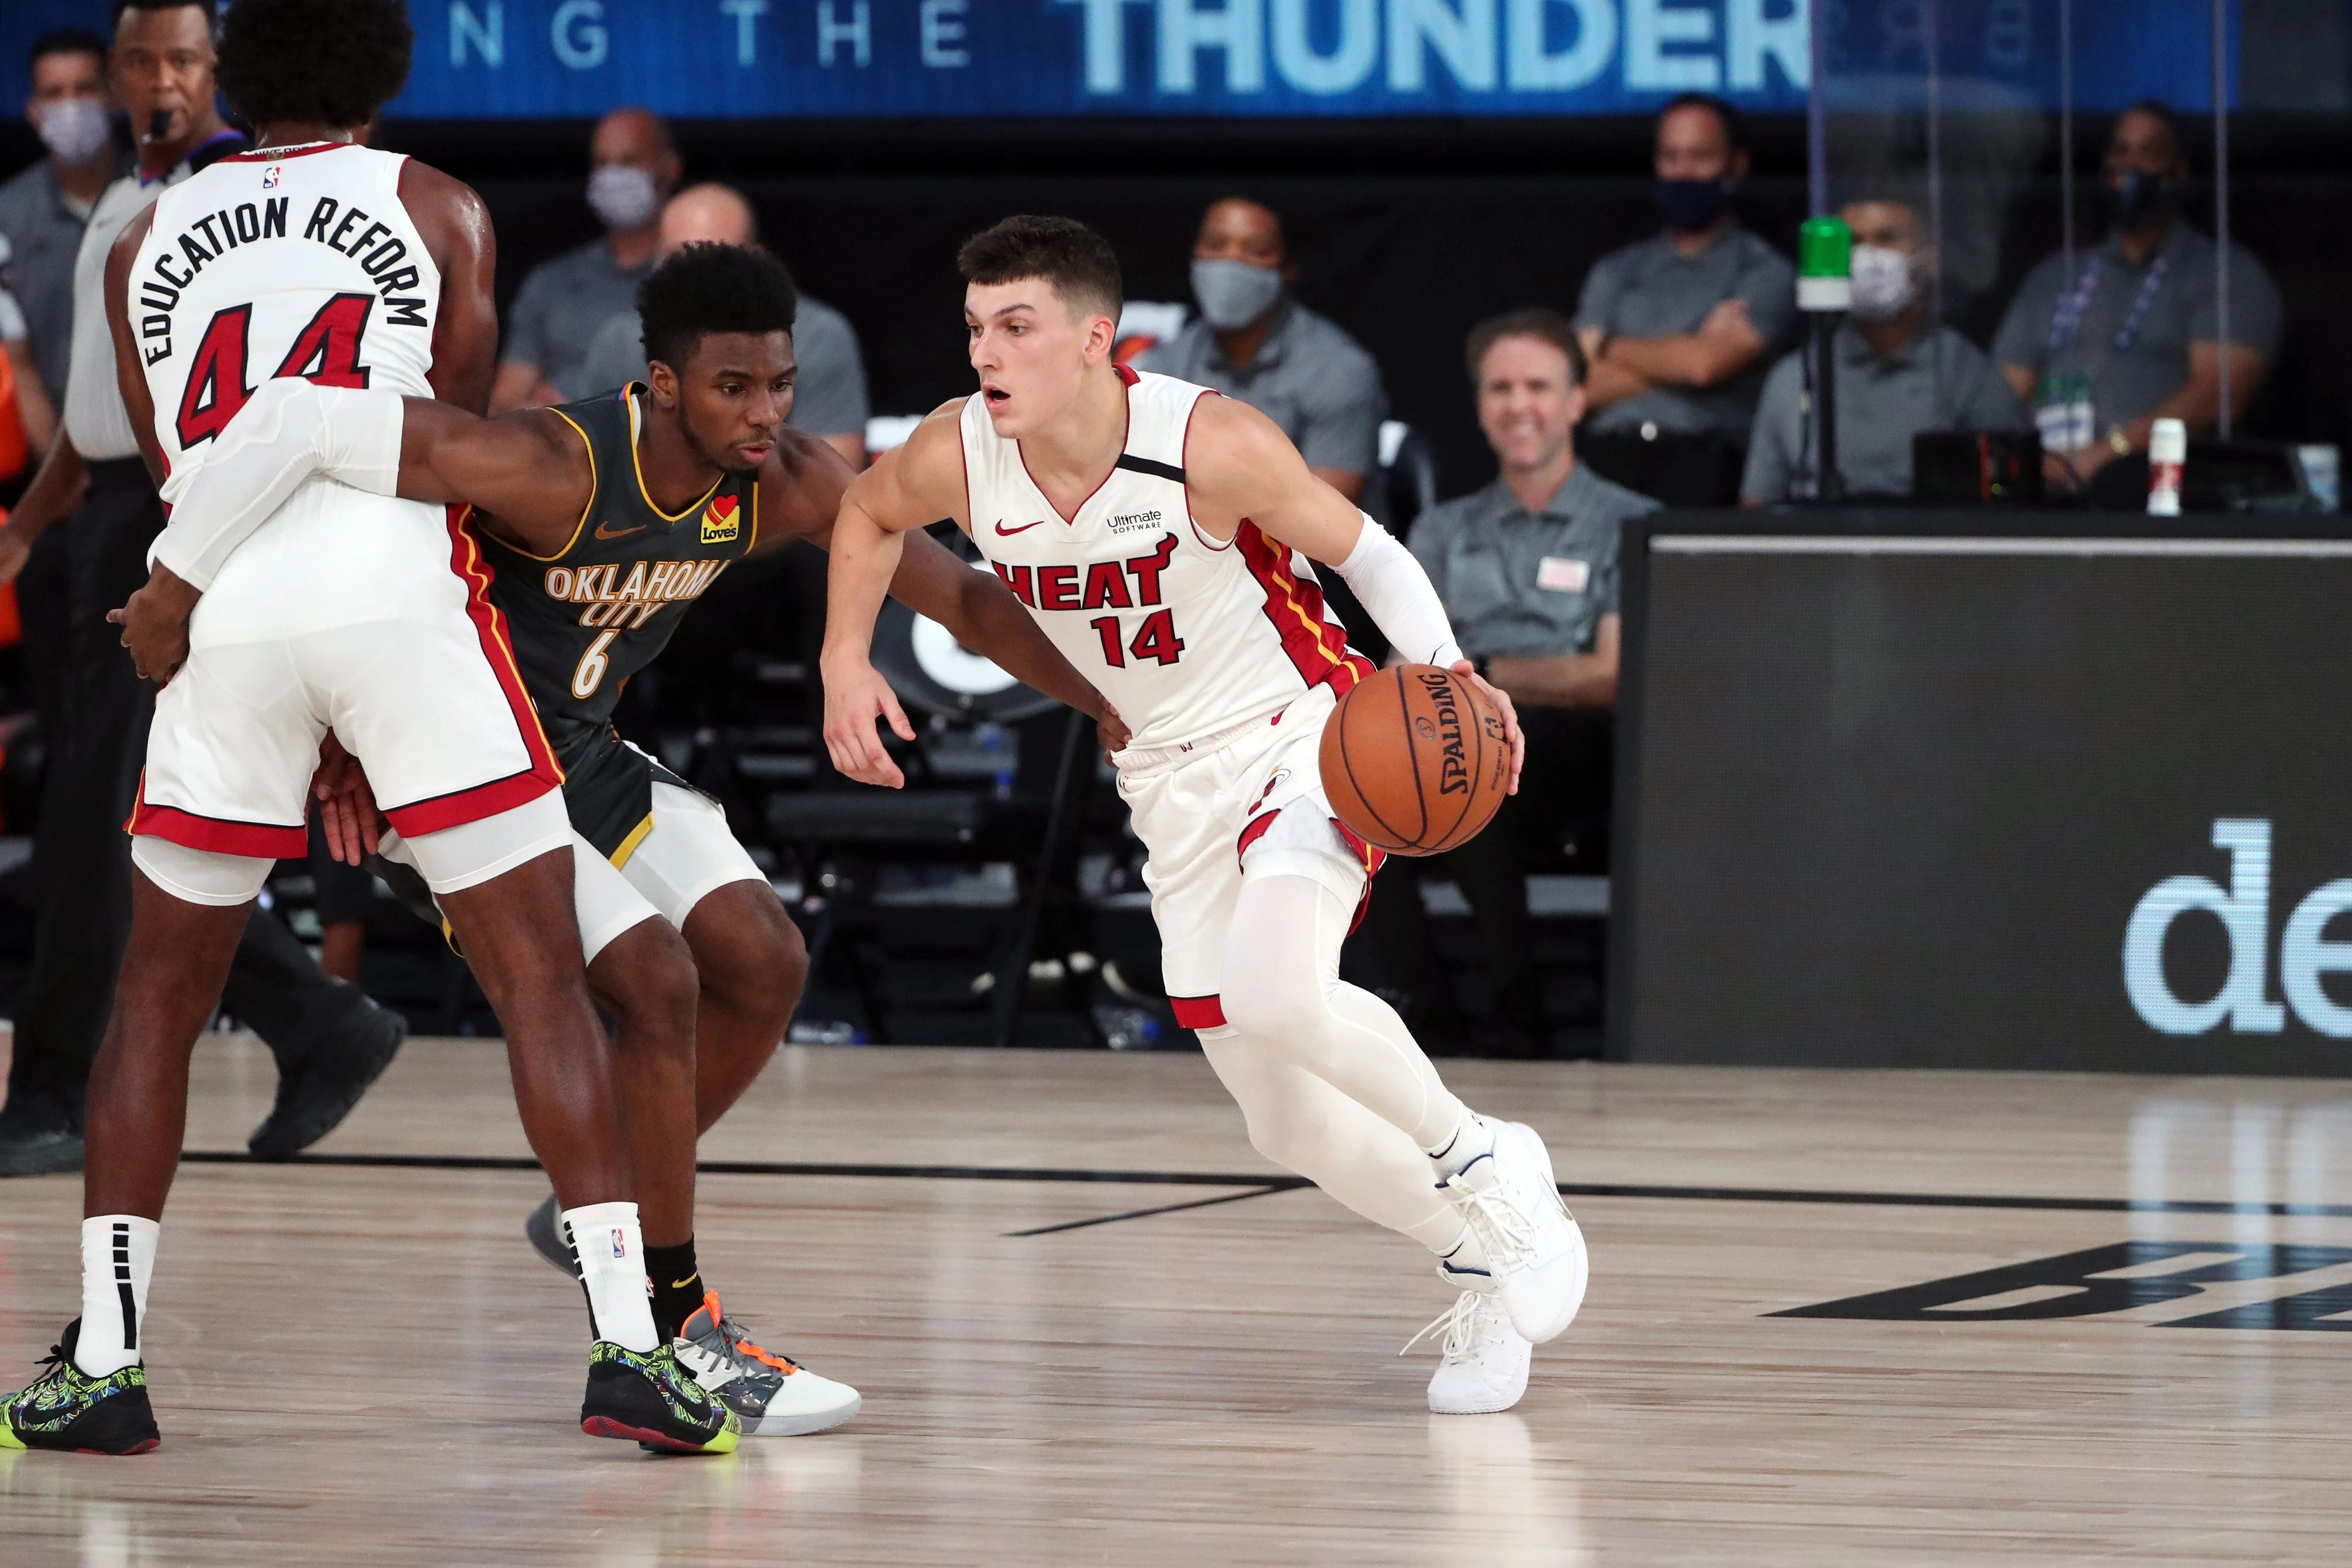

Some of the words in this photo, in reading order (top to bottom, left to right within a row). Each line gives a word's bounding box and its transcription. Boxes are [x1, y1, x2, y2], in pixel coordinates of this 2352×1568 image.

[719, 0, 972, 69] THE
[1055, 0, 1810, 93] THUNDER
[141, 197, 289, 367] EDUCATION
[304, 196, 428, 327] REFORM
[176, 293, 376, 452] 44
[1107, 510, 1162, 528] Ultimate
[1113, 521, 1161, 534] SOFTWARE
[991, 532, 1179, 611] HEAT
[579, 601, 667, 630] CITY
[1090, 607, 1185, 668] 14
[572, 628, 621, 699] 6
[1417, 672, 1469, 796] SPALDING
